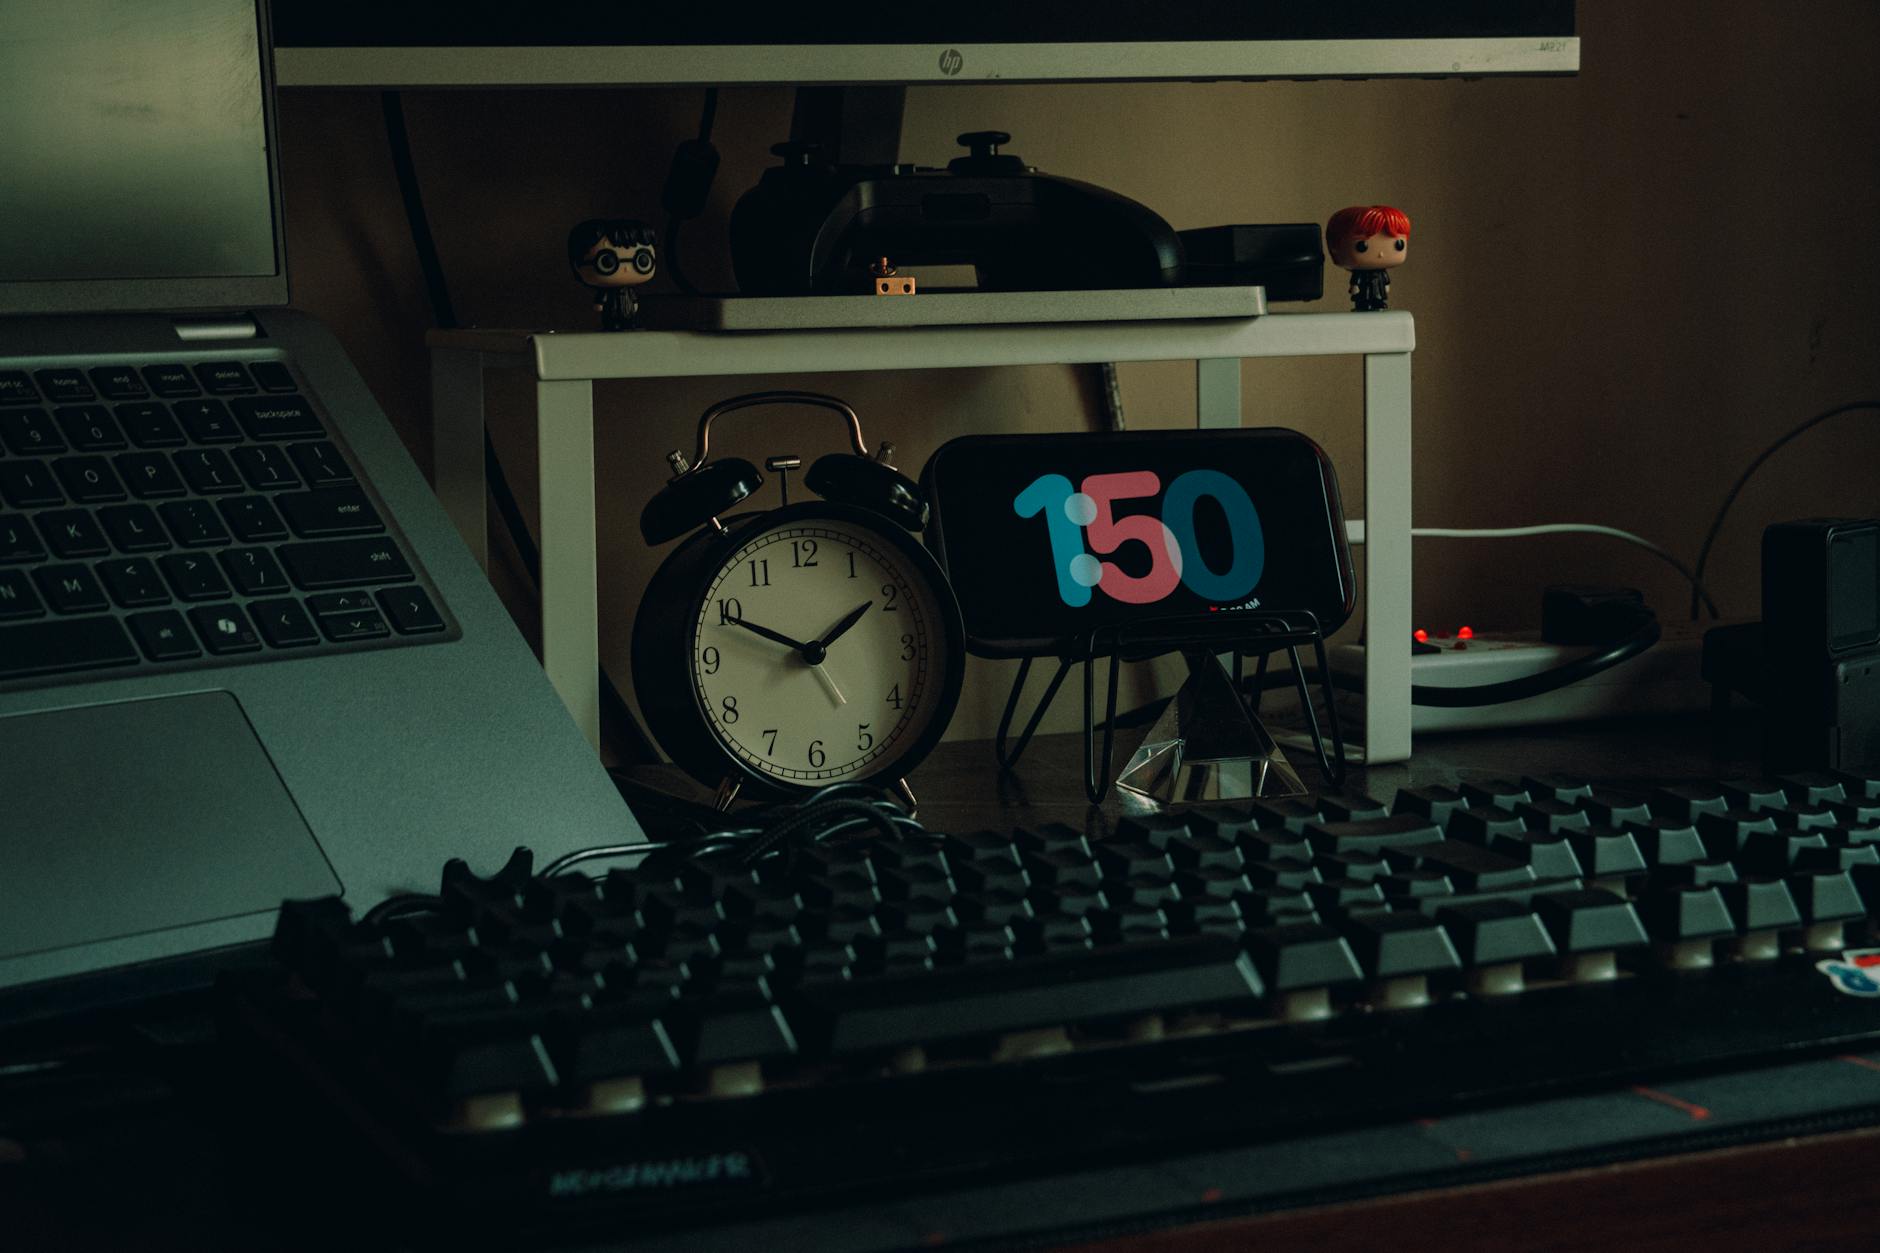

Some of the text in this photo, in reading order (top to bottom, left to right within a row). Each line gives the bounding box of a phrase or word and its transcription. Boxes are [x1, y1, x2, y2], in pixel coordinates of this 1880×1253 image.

[940, 49, 963, 76] hp
[53, 377, 79, 386] home
[112, 375, 130, 384] end
[161, 373, 185, 382] insert
[215, 371, 240, 379] delete
[255, 409, 302, 420] backspace
[30, 430, 42, 442] 9
[144, 465, 157, 479] P
[337, 504, 361, 514] enter
[9, 529, 17, 544] J
[66, 523, 82, 538] K
[129, 519, 144, 533] L
[370, 551, 392, 561] shift
[791, 539, 819, 568] 12
[748, 559, 771, 587] 11
[847, 552, 859, 579] 1
[63, 578, 82, 592] M
[881, 584, 898, 612] 2
[717, 598, 742, 627] 10
[901, 634, 917, 662] 3
[702, 646, 720, 675] 9
[886, 683, 904, 710] 4
[722, 696, 739, 724] 8
[762, 729, 778, 757] 7
[857, 723, 874, 751] 5
[808, 740, 826, 768] 6
